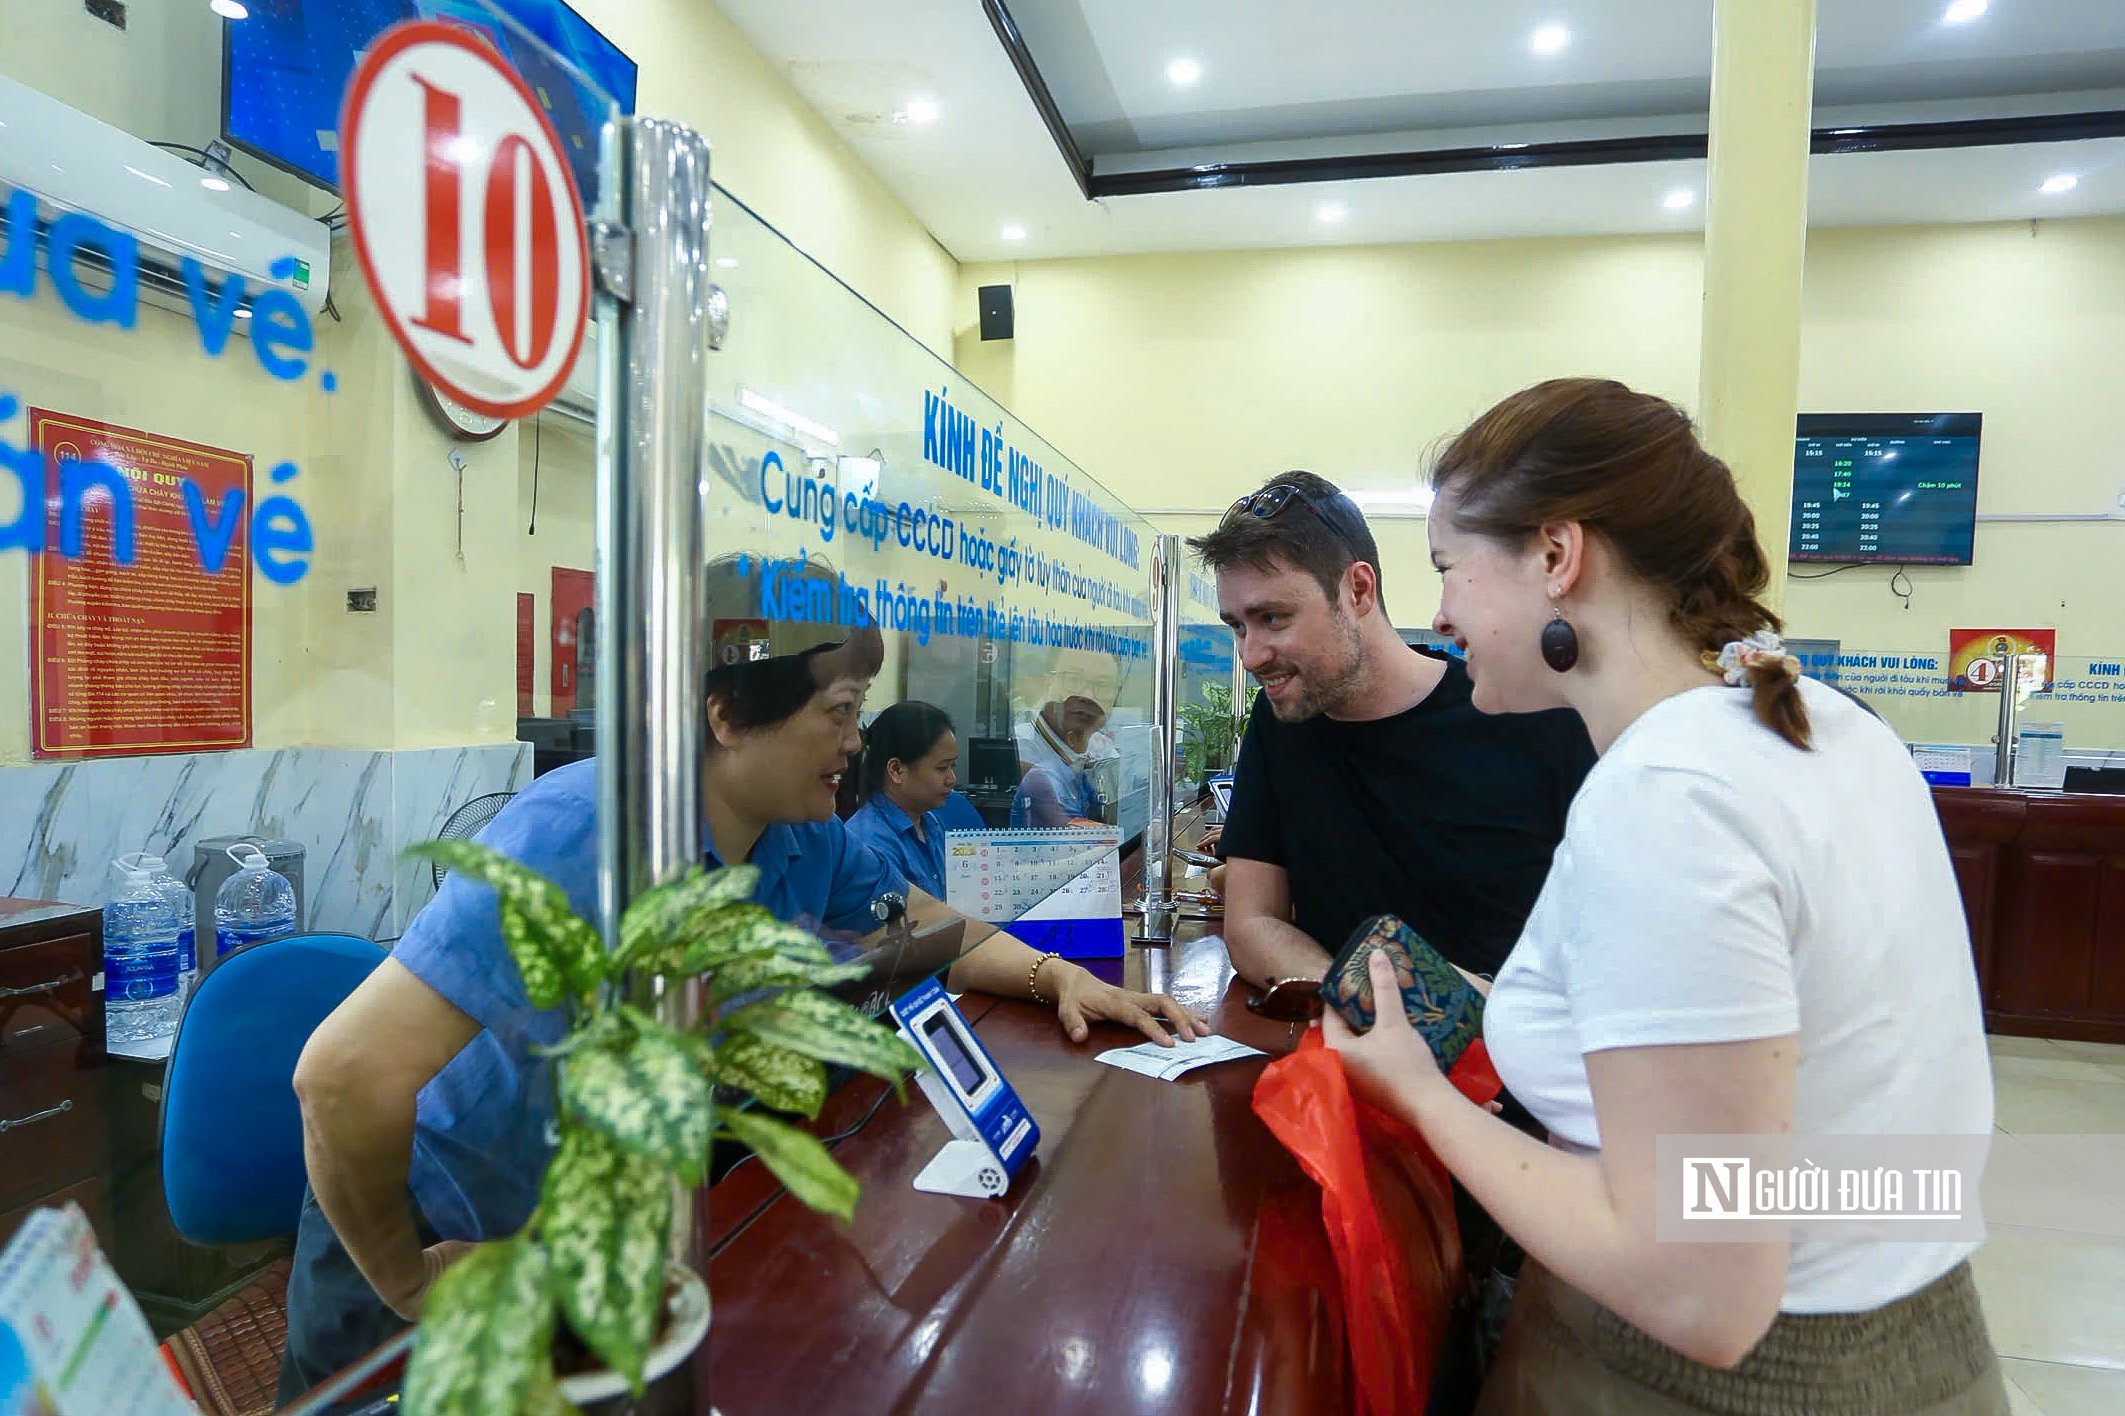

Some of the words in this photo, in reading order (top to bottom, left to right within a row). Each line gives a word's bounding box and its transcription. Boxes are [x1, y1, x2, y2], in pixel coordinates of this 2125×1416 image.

[409, 72, 560, 370] 10
[182, 257, 337, 392] vé.
[924, 386, 976, 483] KÍNH
[1008, 446, 1043, 529] NGHỊ
[1046, 473, 1069, 532] QUÝ
[181, 462, 314, 586] vé
[761, 451, 836, 543] Cung
[844, 478, 888, 552] cấp
[897, 502, 954, 561] CCCD
[960, 522, 994, 579] hoặc
[997, 536, 1022, 588] giấy
[1024, 544, 1035, 583] tờ
[1052, 558, 1071, 595] thân
[760, 545, 832, 623] Kiểm
[838, 570, 870, 628] tra
[875, 578, 930, 646] thông
[935, 588, 954, 636] tin
[957, 593, 983, 639] trên
[987, 597, 1005, 641] thẻ
[1009, 605, 1025, 644] lên
[1027, 607, 1044, 646] tàu
[1837, 653, 1877, 669] KHÁCH
[1881, 656, 1900, 669] VUI
[1970, 662, 1987, 682] 4
[2078, 681, 2109, 690] CCCD
[2088, 661, 2121, 676] KÍNH
[961, 859, 969, 869] 6
